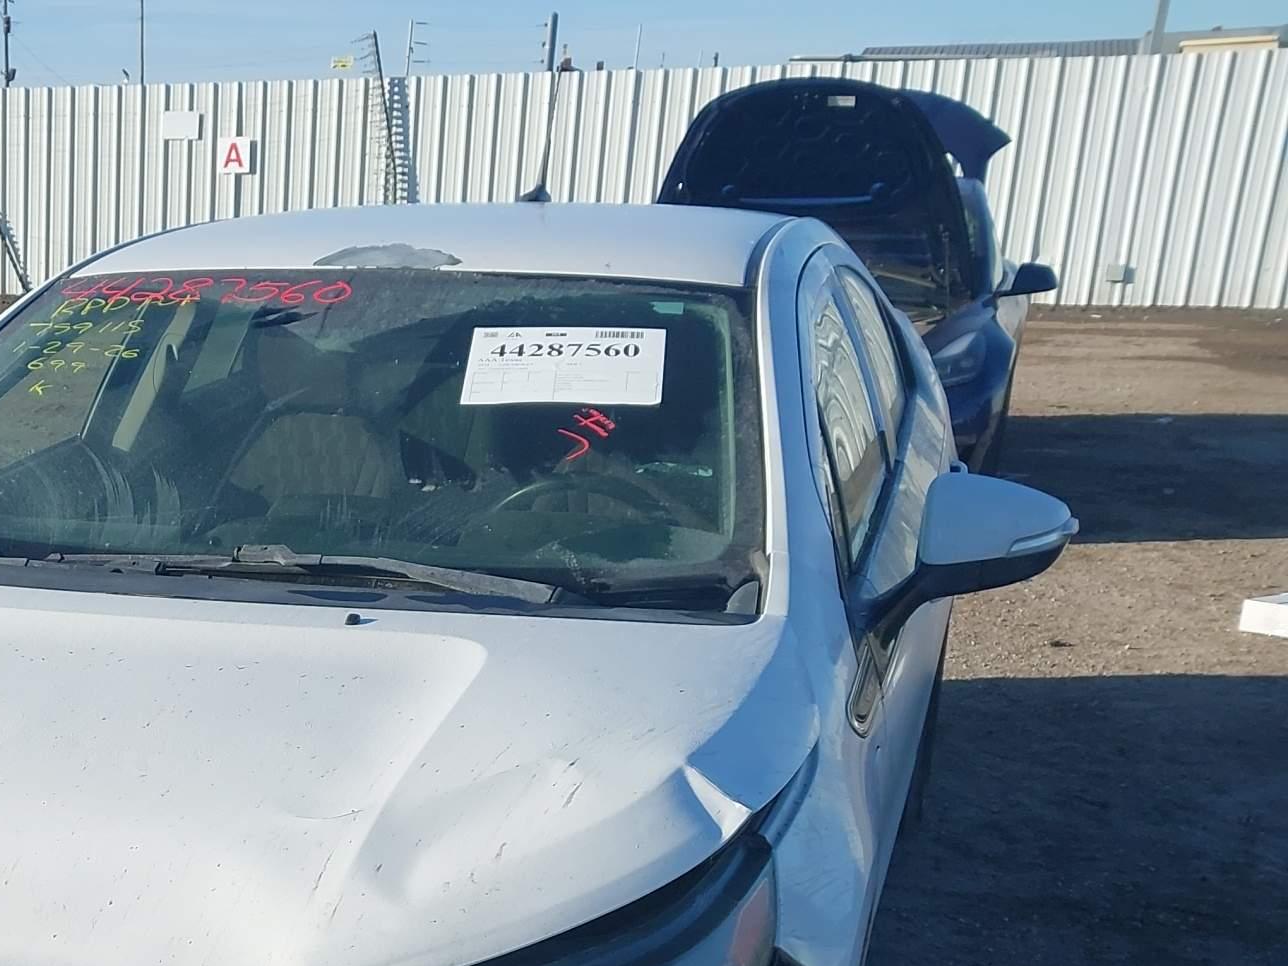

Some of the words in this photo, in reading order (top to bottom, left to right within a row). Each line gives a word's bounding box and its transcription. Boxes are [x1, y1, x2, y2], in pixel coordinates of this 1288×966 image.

[223, 142, 244, 168] A
[62, 277, 353, 304] 44287560
[490, 343, 641, 358] 44287560
